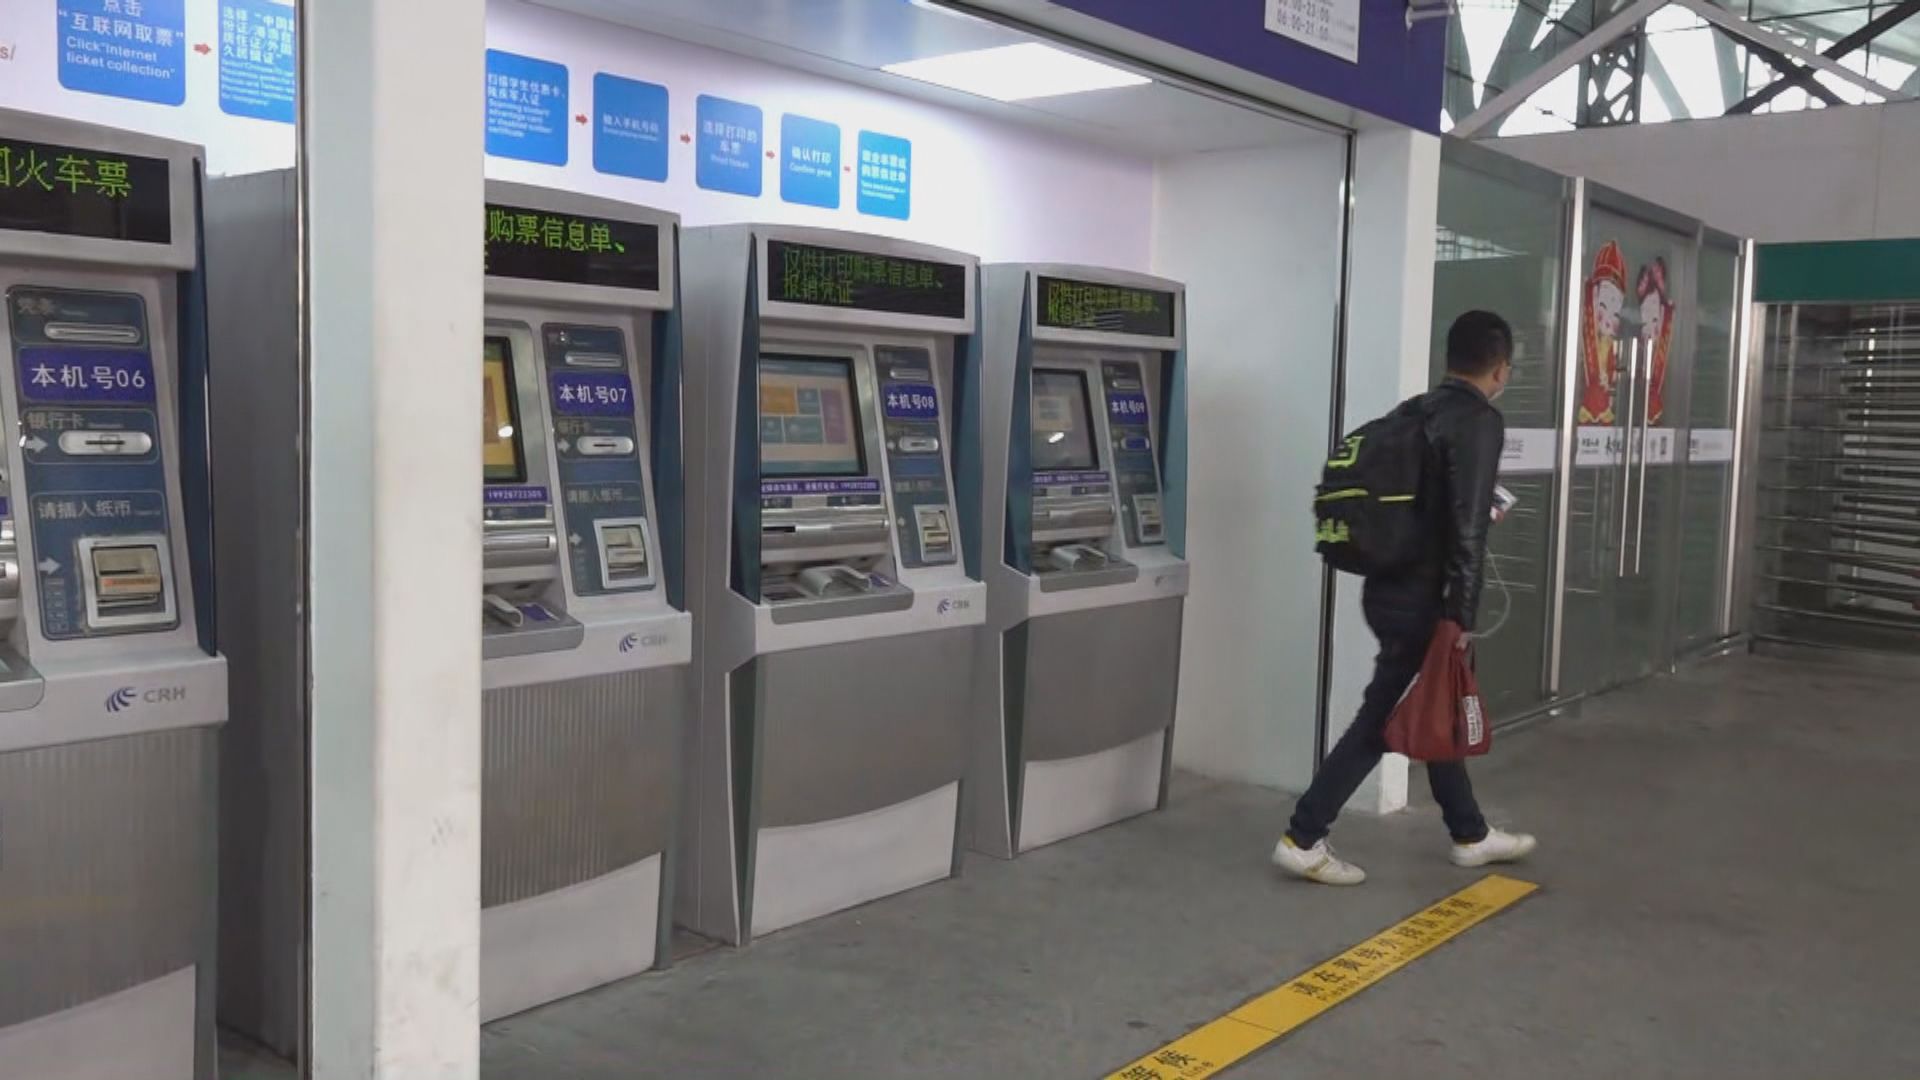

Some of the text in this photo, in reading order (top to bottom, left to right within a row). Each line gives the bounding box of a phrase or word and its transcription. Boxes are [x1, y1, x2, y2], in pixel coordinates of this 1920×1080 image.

[103, 0, 143, 17] 点击
[66, 53, 104, 69] ticket
[31, 363, 146, 390] 本机号06
[559, 383, 627, 405] 本机号07
[887, 393, 935, 411] 本机号08
[38, 500, 131, 518] 请插入纸币
[143, 687, 187, 703] CRH
